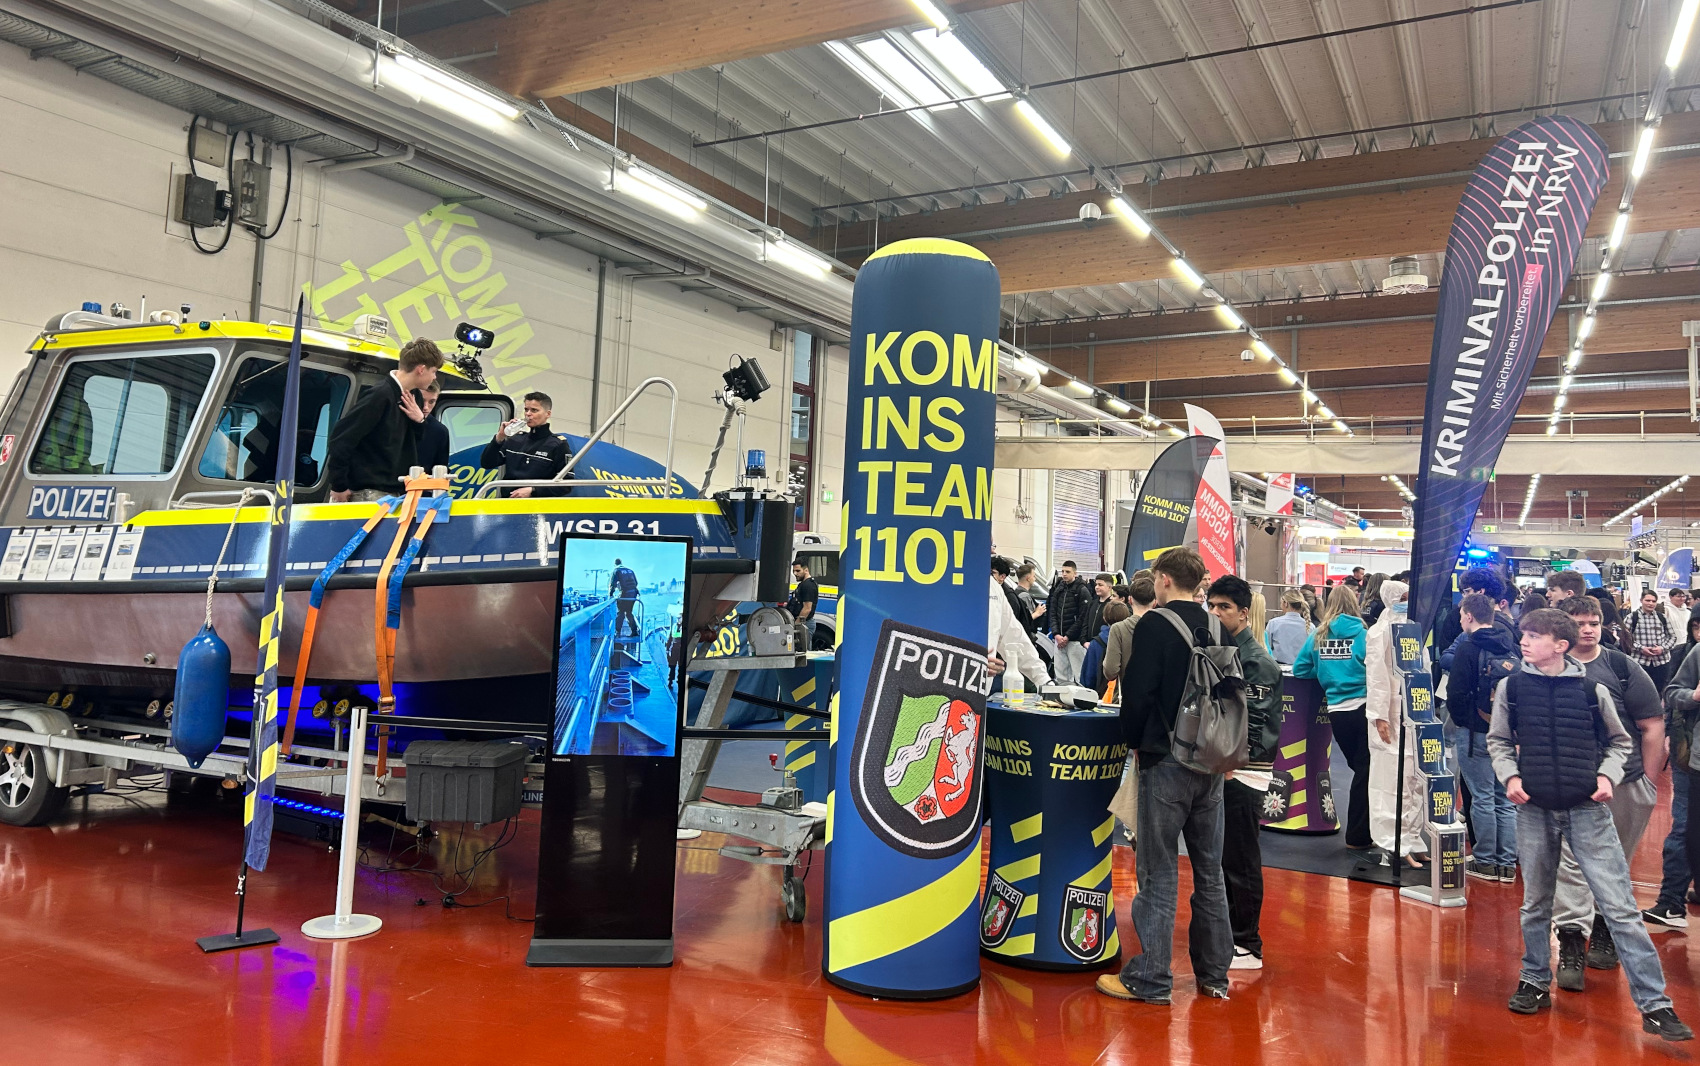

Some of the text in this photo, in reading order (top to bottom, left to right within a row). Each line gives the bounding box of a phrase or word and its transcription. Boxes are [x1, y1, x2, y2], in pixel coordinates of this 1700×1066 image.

[1525, 143, 1580, 254] in NRW
[1431, 142, 1549, 477] KRIMINALPOLIZEI
[1490, 266, 1538, 411] Mit Sicherheit vorbereitet.
[864, 330, 998, 394] KOM
[861, 396, 965, 452] INS
[28, 487, 113, 519] POLIZEI
[1143, 494, 1190, 515] KOMM INS
[1142, 504, 1186, 524] TEAM 110!
[853, 526, 966, 585] 110!
[1400, 643, 1420, 652] TEAM
[894, 640, 988, 696] POLIZE
[1411, 693, 1431, 702] TEAM
[1003, 738, 1032, 756] INS
[1052, 743, 1128, 760] KOMM INS
[1422, 744, 1442, 754] TEAM
[1003, 757, 1033, 776] 110!
[1049, 761, 1124, 780] TEAM 110!
[1433, 797, 1453, 807] TEAM
[992, 875, 1020, 905] POLIZEI
[1068, 890, 1104, 907] POLIZEI
